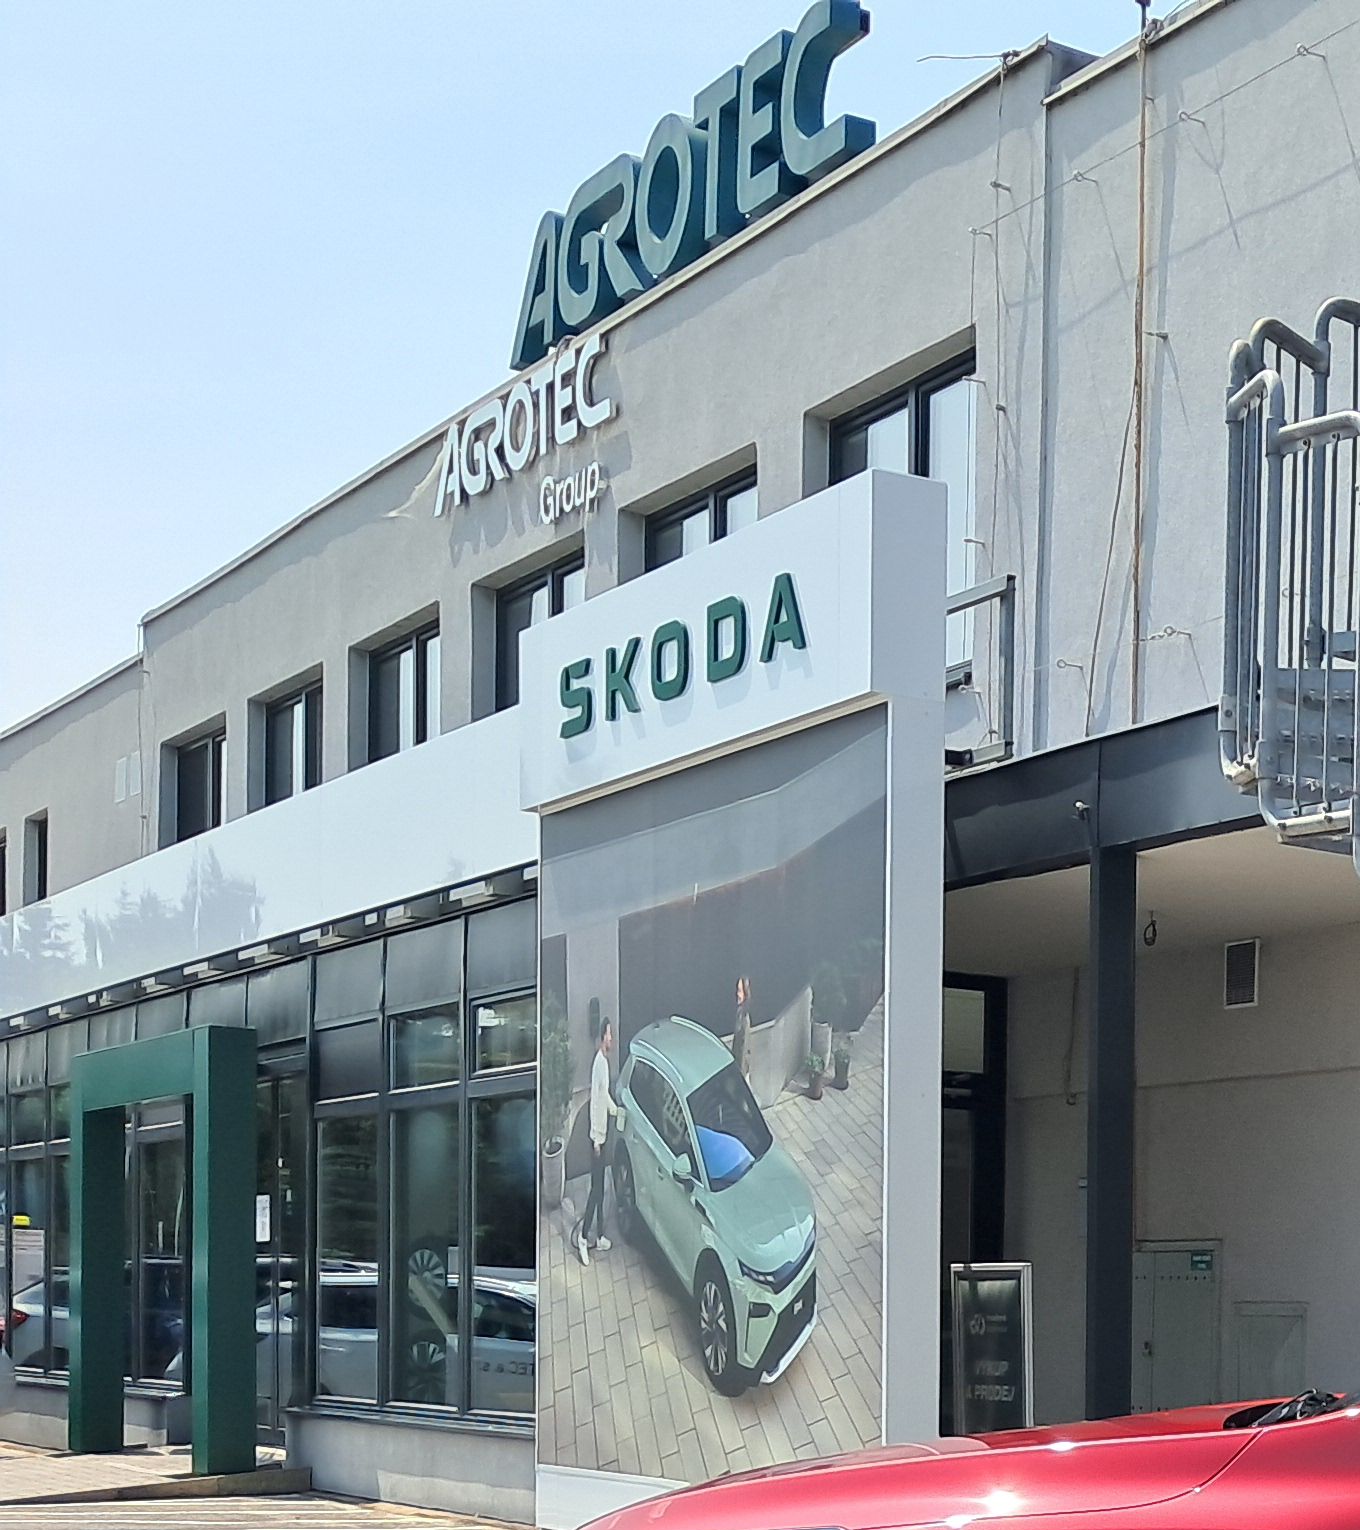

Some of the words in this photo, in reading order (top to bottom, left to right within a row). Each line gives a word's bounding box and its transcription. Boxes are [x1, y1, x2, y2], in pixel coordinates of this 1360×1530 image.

[509, 0, 876, 371] AGROTEC
[435, 335, 614, 518] AGROTEC
[540, 459, 600, 525] Group
